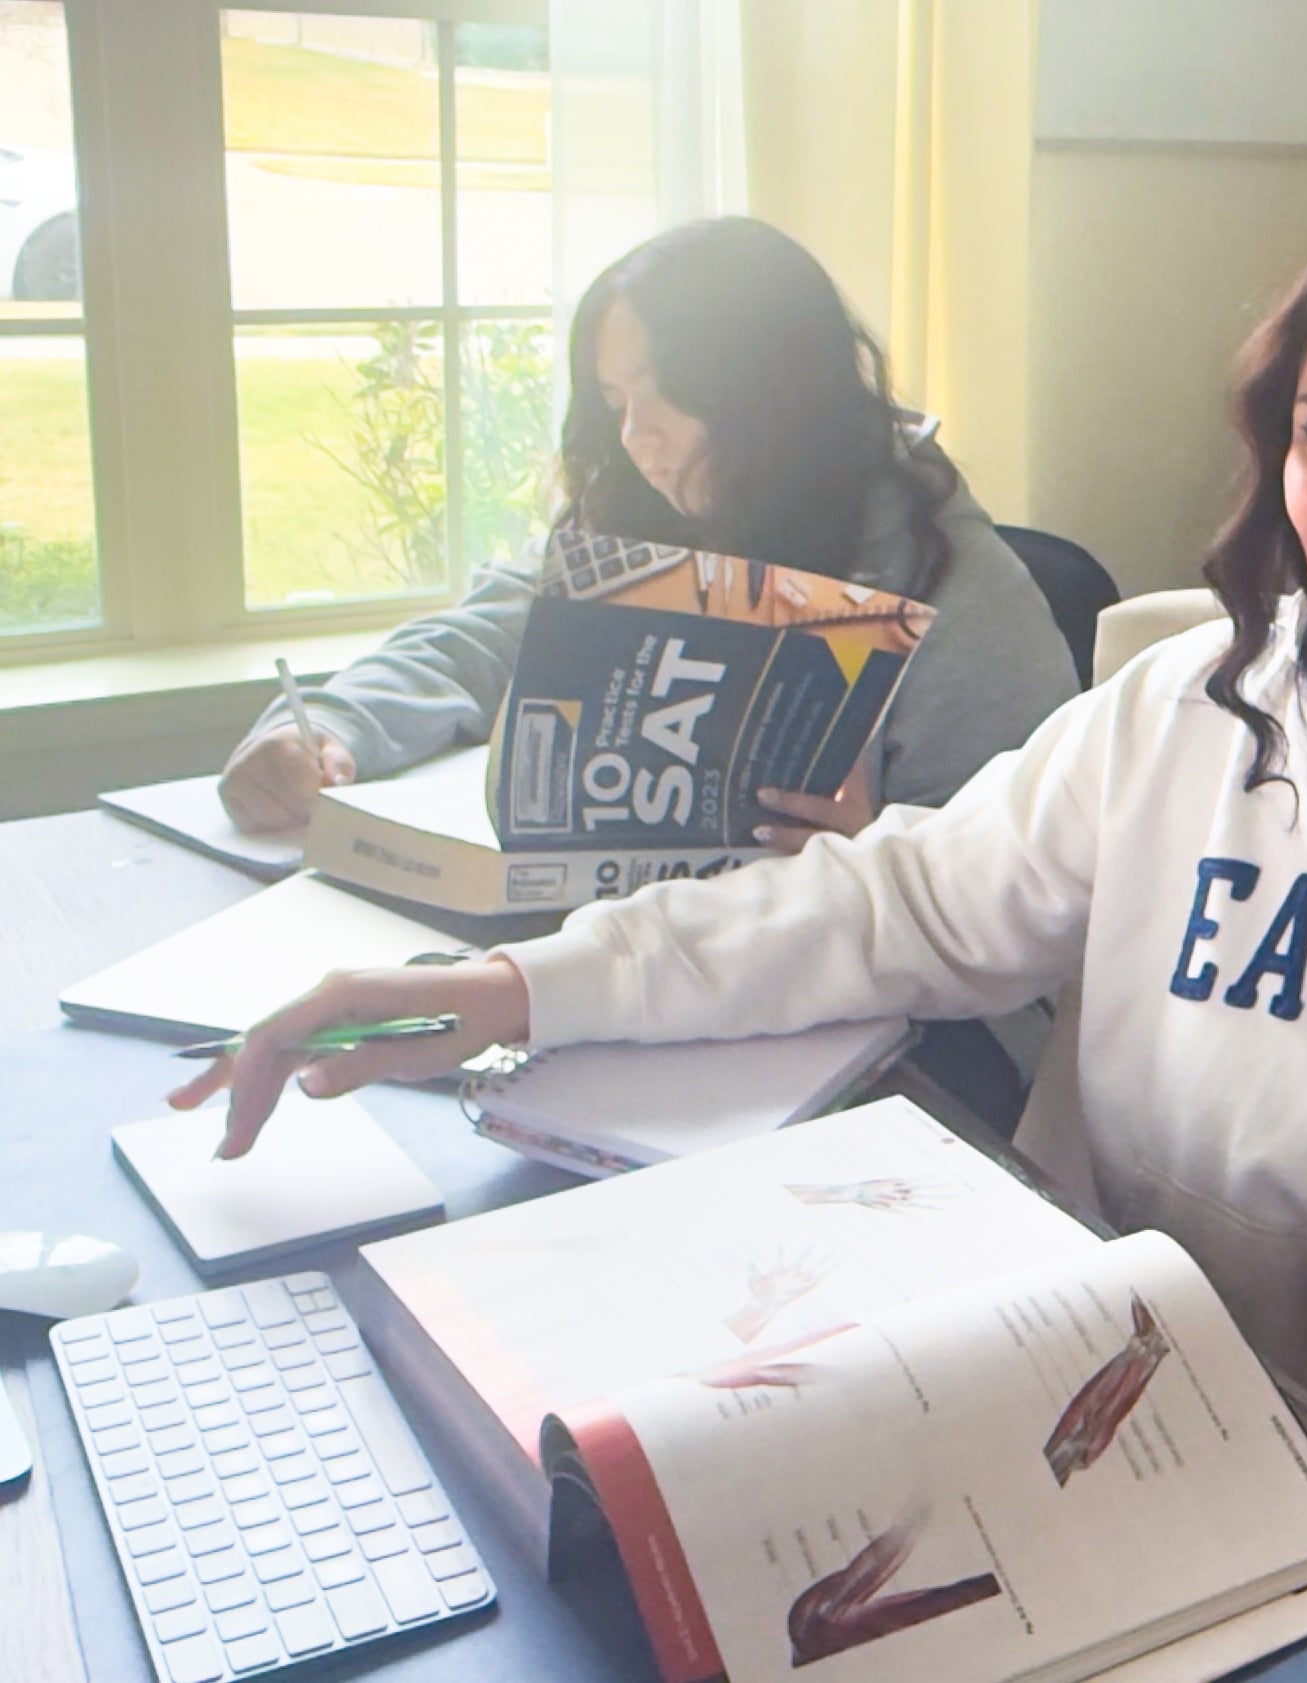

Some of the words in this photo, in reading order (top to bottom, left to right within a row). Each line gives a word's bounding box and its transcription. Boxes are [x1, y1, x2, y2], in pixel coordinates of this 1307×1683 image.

[635, 634, 658, 665] the
[595, 667, 626, 748] Practice
[625, 669, 646, 696] for
[614, 699, 639, 748] Tests
[632, 637, 727, 828] SAT
[582, 752, 632, 831] 10
[701, 768, 721, 831] 2023
